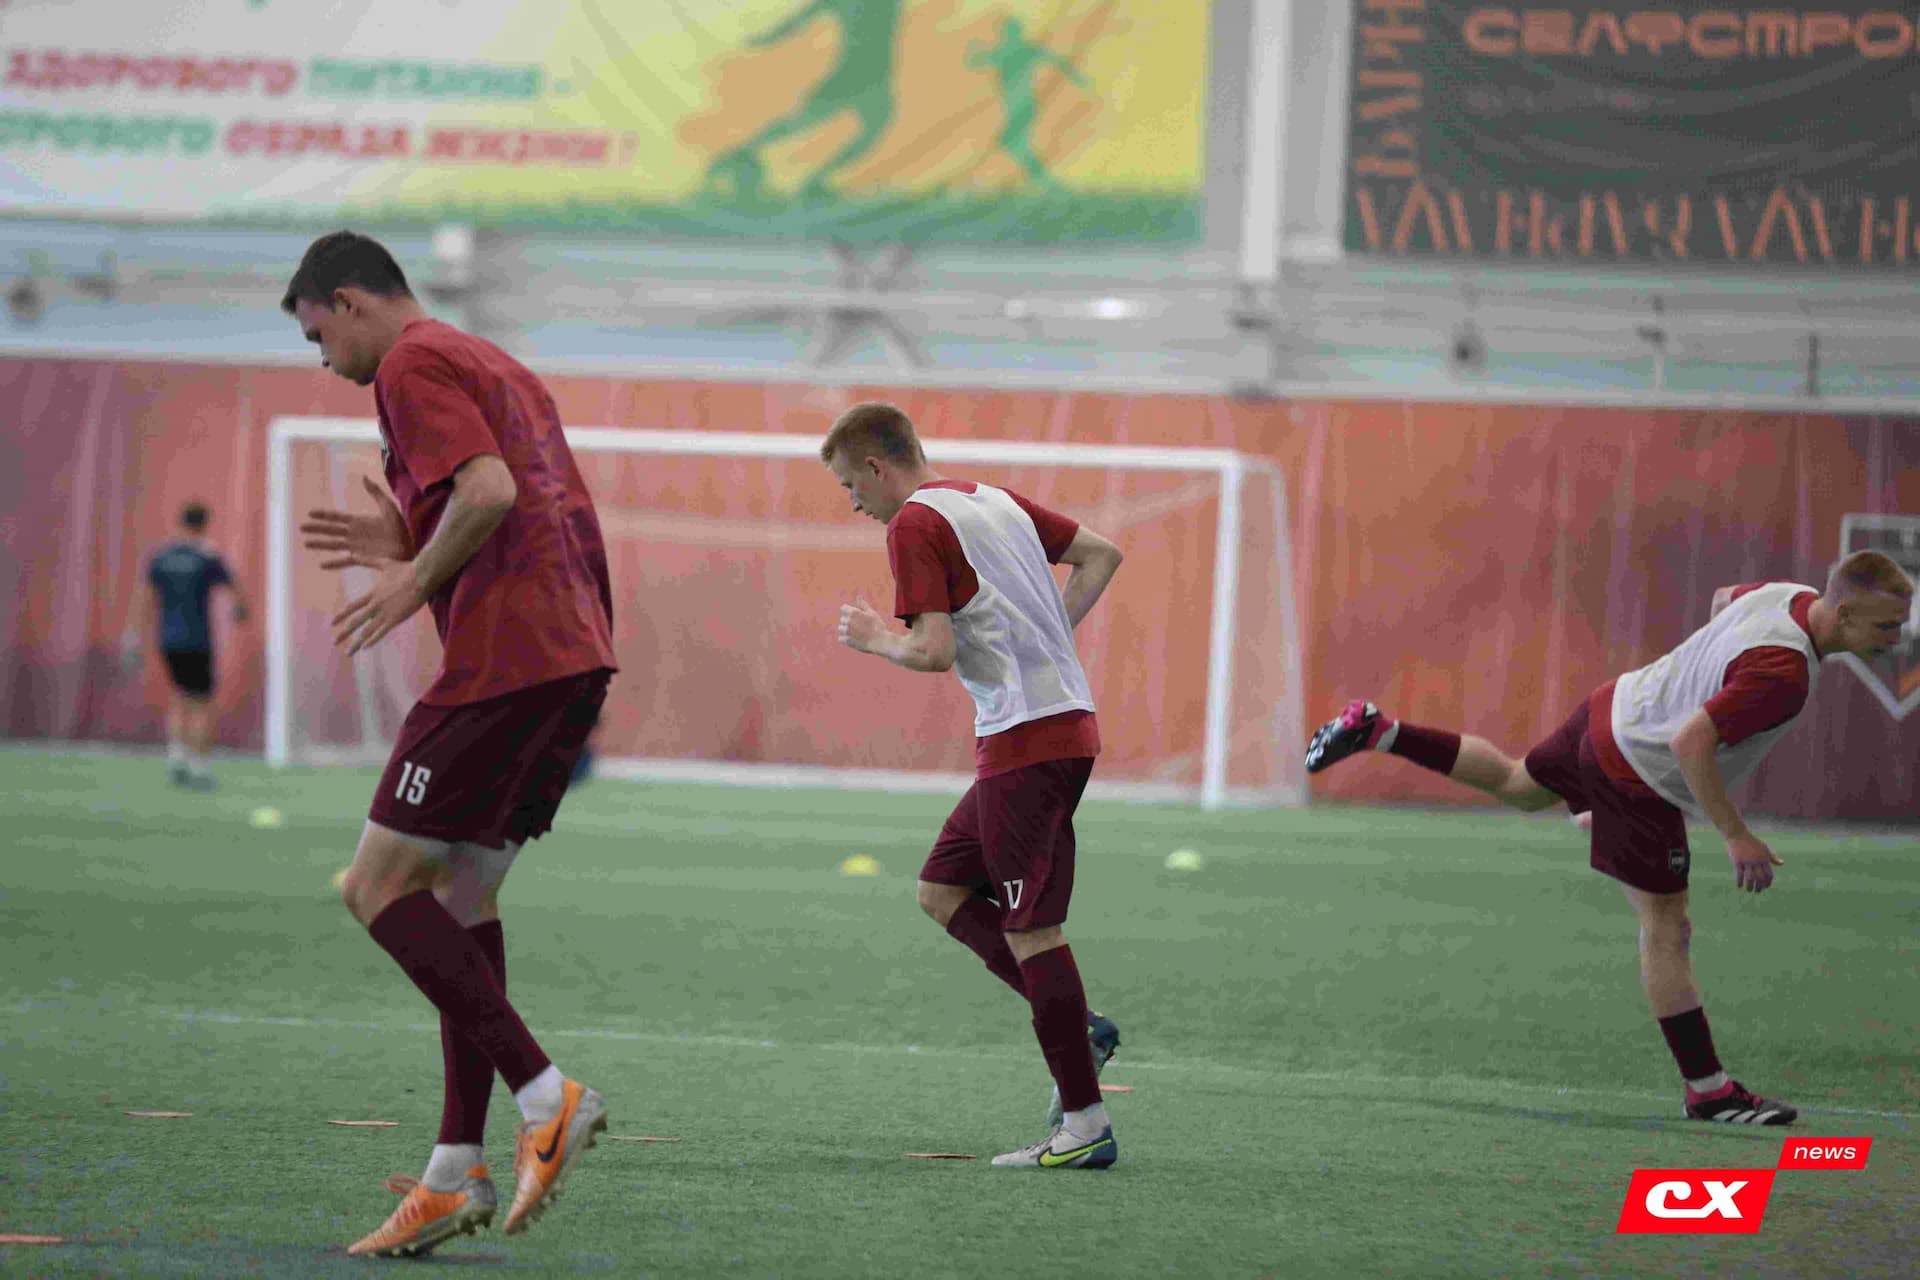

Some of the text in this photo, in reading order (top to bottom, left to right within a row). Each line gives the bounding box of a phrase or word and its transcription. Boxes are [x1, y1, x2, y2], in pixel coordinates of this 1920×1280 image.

[1463, 10, 1920, 58] СЕЛФСТРО
[395, 760, 432, 806] 15
[1003, 879, 1024, 911] 17
